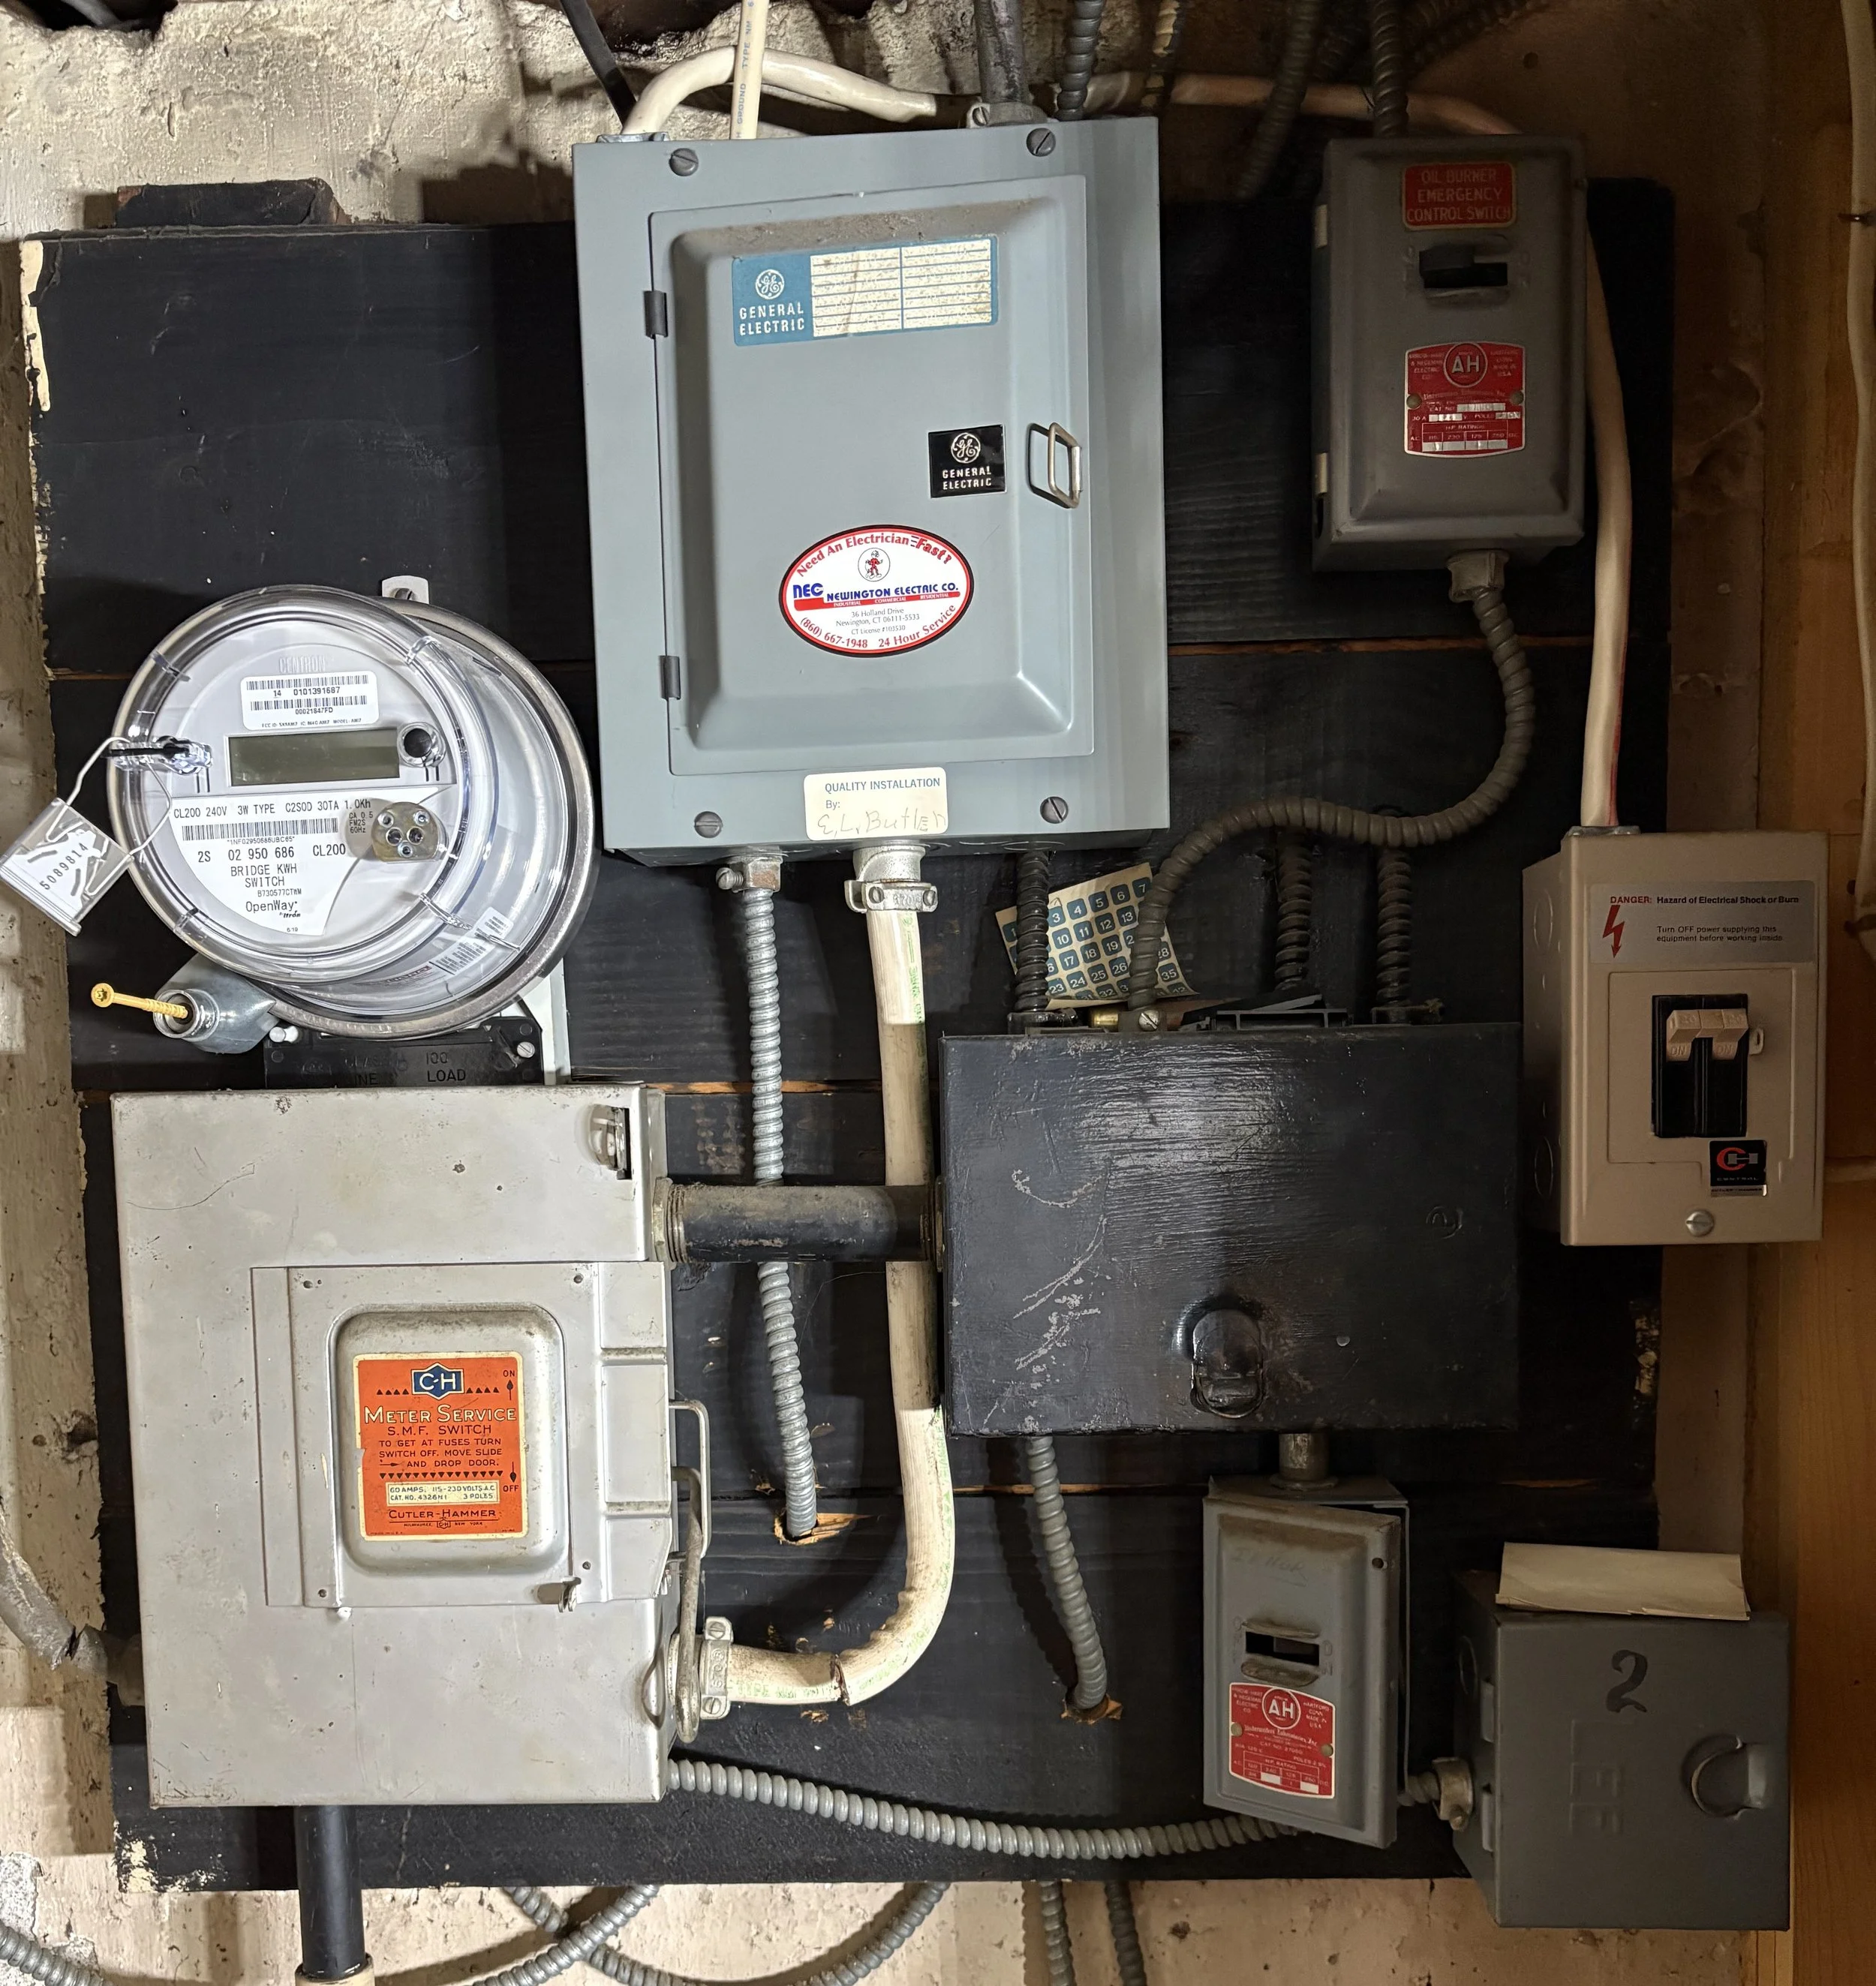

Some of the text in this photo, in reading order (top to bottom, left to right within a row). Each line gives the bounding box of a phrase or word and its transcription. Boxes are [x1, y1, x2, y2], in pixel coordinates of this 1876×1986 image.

[745, 21, 752, 35] NM
[741, 42, 751, 69] TYPE
[737, 83, 746, 125] GROUND
[1421, 168, 1497, 184] OIL BURNER
[1418, 188, 1502, 203] EMERGENCY
[1407, 206, 1511, 222] CONTROL SWITCH
[739, 302, 804, 320] GENERAL
[739, 318, 804, 336] ELECTRIC
[1451, 355, 1480, 373] AH
[943, 466, 992, 479] GENERAL
[943, 478, 992, 490] ELECTRIC
[796, 533, 952, 578] Need An Electrician Fast?
[793, 583, 824, 599] NEC
[827, 582, 959, 602] NEWINGTON ELECTRIC CO.
[874, 596, 906, 604] COMMERCIAL
[861, 608, 885, 617] Holland
[887, 607, 904, 615] Drive
[800, 604, 956, 648] (860) 667-1948 24 Hour Service
[836, 617, 871, 627] Newington,
[882, 614, 920, 623] 06111-5533
[860, 626, 880, 635] License
[278, 656, 326, 674] CENTRON
[825, 778, 940, 794] QUALITY INSTALLATION
[173, 806, 201, 819] CL200
[206, 804, 227, 818] 240V
[237, 804, 249, 816] 3W
[253, 803, 276, 815] TYPE
[825, 800, 840, 810] By:
[349, 819, 366, 827] FM2S
[350, 825, 366, 834] 60Hz
[197, 843, 346, 863] 2S 02 950 686 CL200
[230, 863, 297, 877] BRIDGE KWH
[245, 876, 285, 888] SWITCH
[245, 900, 294, 914] OpenWay
[1052, 884, 1147, 923] 3 4 5 6 7
[1610, 896, 1652, 904] DANGER:
[1657, 896, 1687, 904] Hazard
[1688, 896, 1697, 904] of
[1699, 896, 1738, 904] Electrical
[1739, 896, 1767, 904] Shock
[1057, 912, 1133, 945] 10 11 12 13
[1722, 925, 1760, 933] supplying
[1063, 956, 1074, 967] 17
[1084, 948, 1097, 960] 18
[1106, 941, 1119, 951] 19
[1048, 962, 1127, 994] 23 24 25 26
[1099, 989, 1114, 998] 32
[1162, 969, 1177, 981] 35
[427, 1068, 466, 1083] LOAD
[365, 1405, 516, 1424] METER SERVICE
[387, 1424, 492, 1436] S.M.F. SWITCH
[438, 1438, 471, 1447] FUSES
[379, 1450, 416, 1458] SWITCH
[468, 1459, 500, 1467] DOOR.
[389, 1508, 497, 1519] CUTLER-HAMMER
[1606, 1649, 1648, 1714] 2
[1268, 1699, 1294, 1720] AH
[1303, 1702, 1330, 1711] HARTFORD
